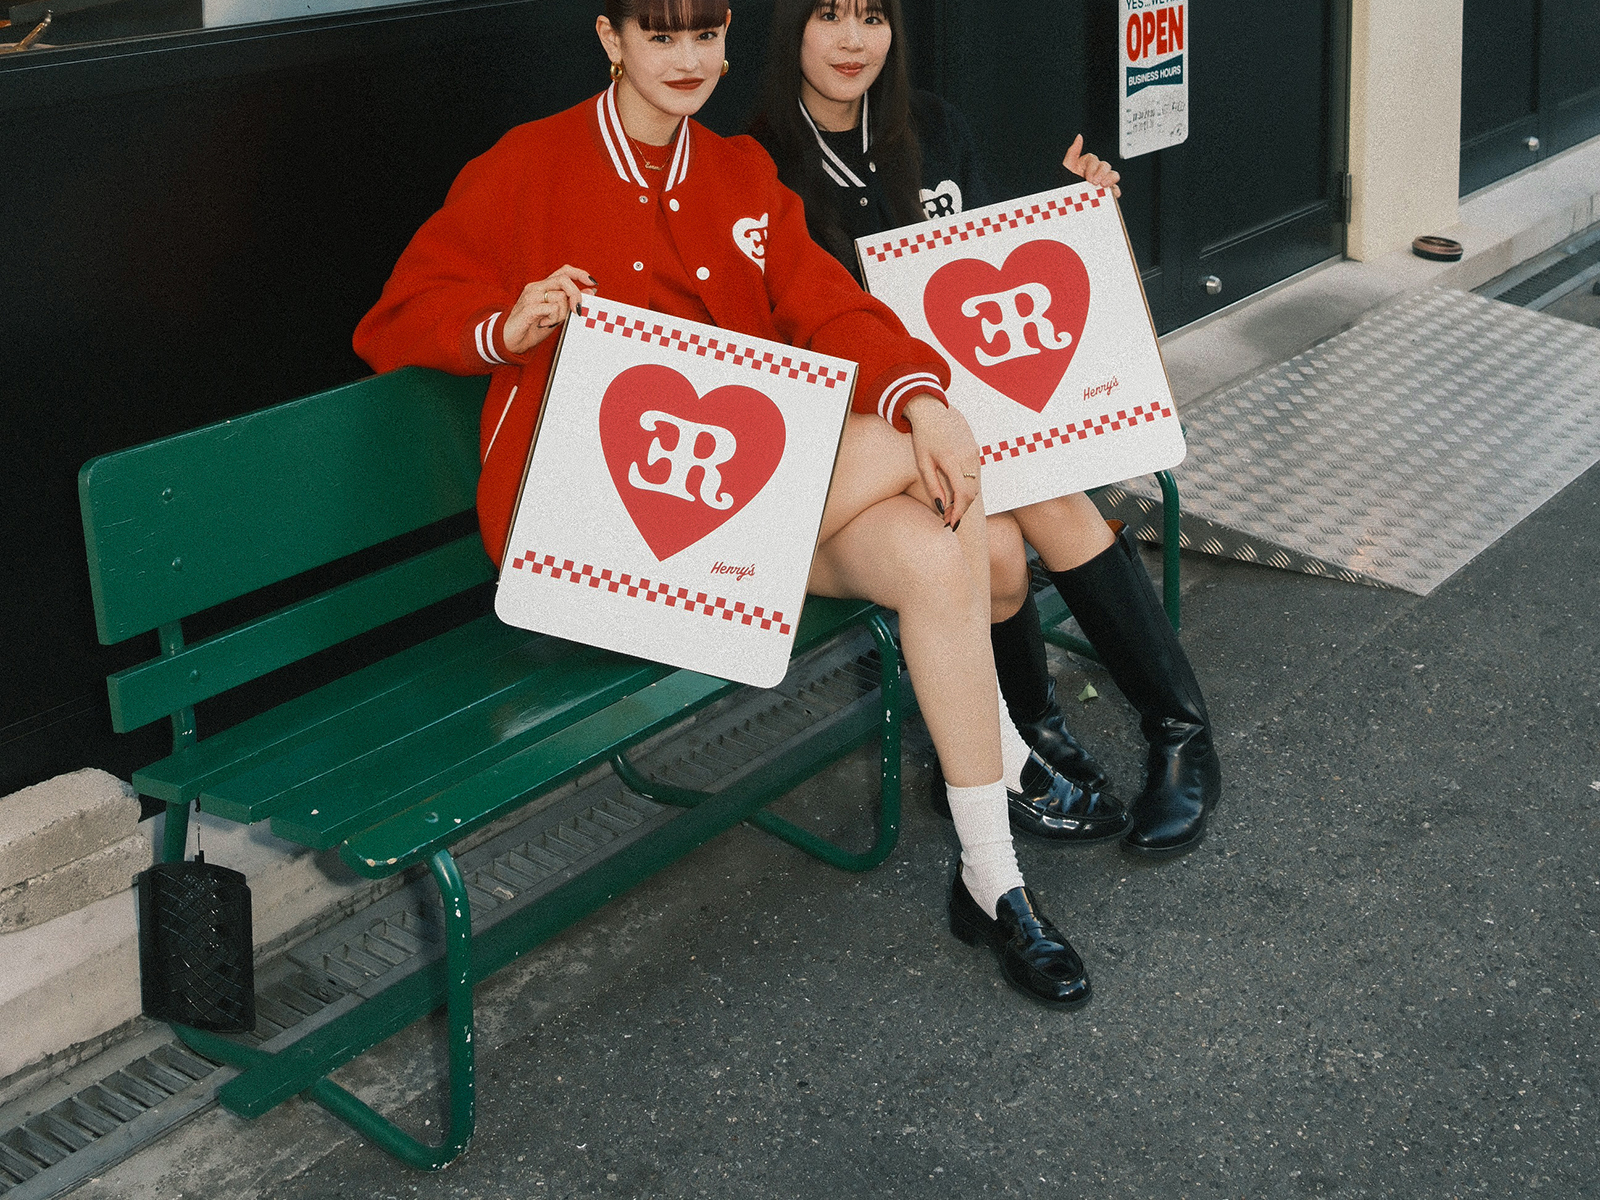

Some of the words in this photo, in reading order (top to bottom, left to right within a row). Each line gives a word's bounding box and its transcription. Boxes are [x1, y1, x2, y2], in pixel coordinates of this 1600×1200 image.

[1126, 4, 1184, 62] OPEN
[1128, 70, 1159, 87] BUSINESS
[1159, 65, 1182, 79] HOURS
[1083, 375, 1119, 401] Henry's
[710, 561, 756, 582] Henry's
